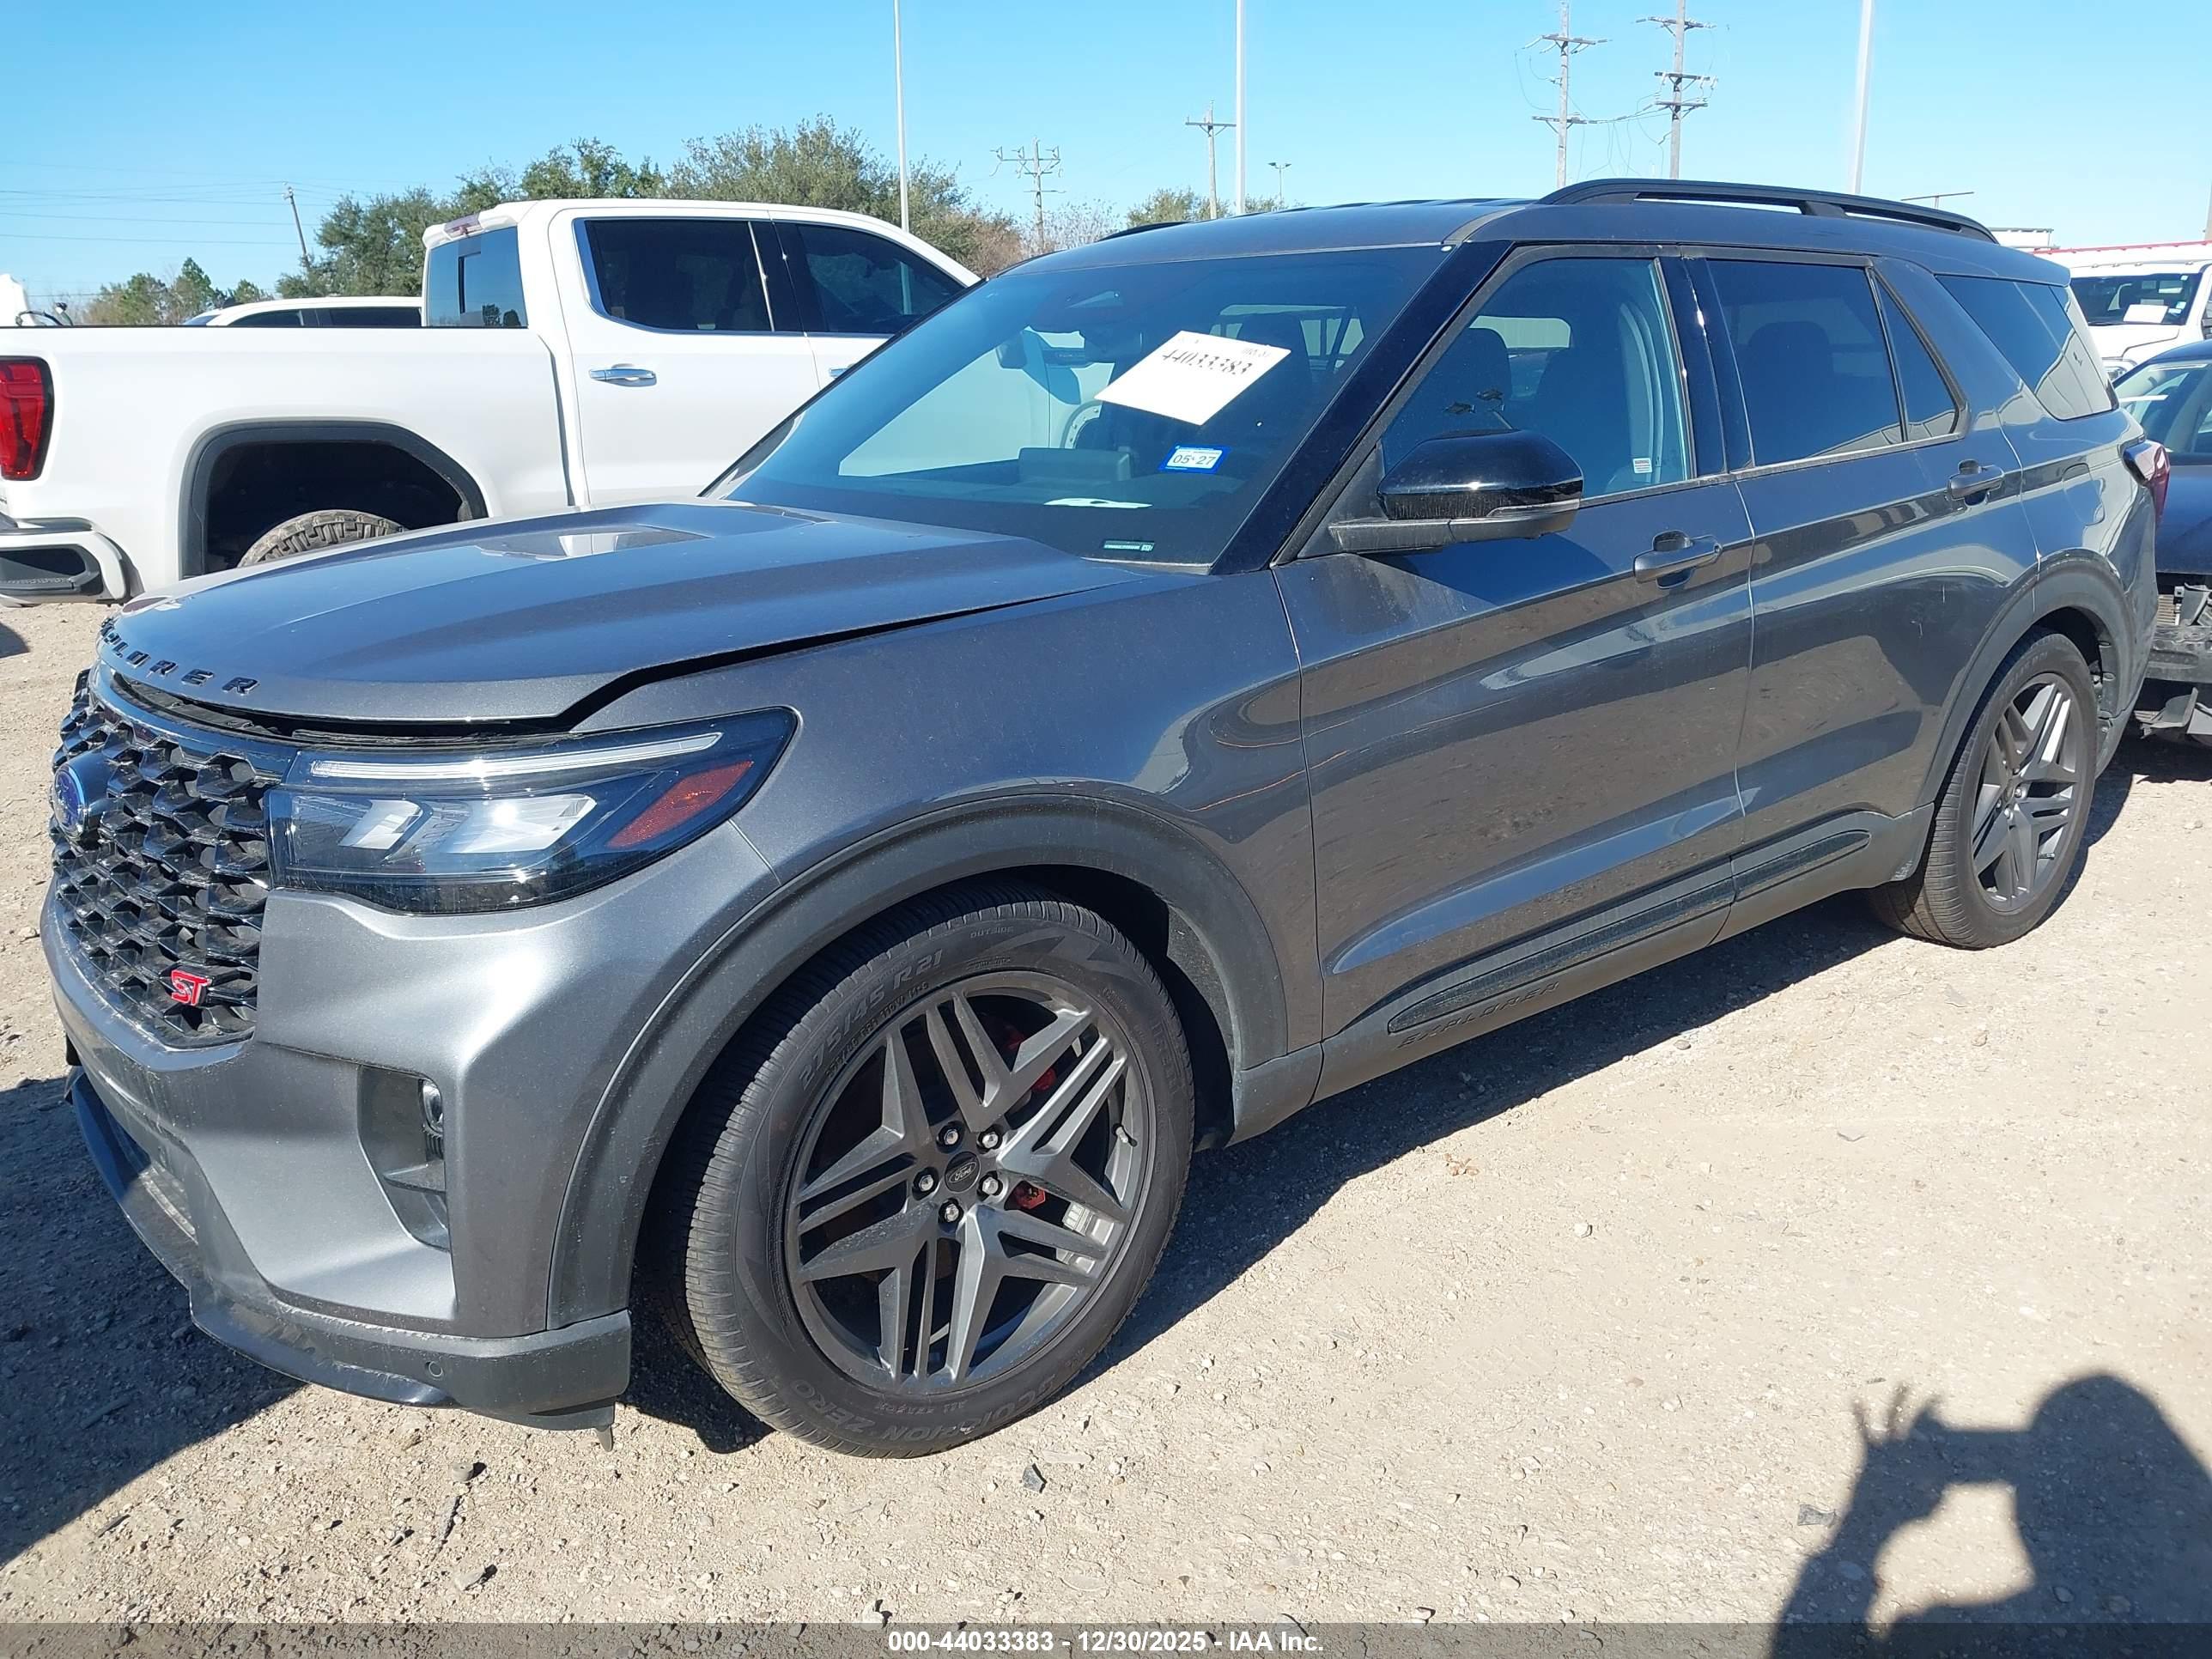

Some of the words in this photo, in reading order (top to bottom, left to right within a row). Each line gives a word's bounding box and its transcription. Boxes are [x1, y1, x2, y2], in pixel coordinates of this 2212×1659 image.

[1173, 454, 1192, 465] 05
[1195, 455, 1217, 465] 27
[171, 969, 213, 1006] ST
[799, 983, 885, 1091] 275/45
[893, 948, 943, 990] R21
[793, 1379, 877, 1434] ZERO
